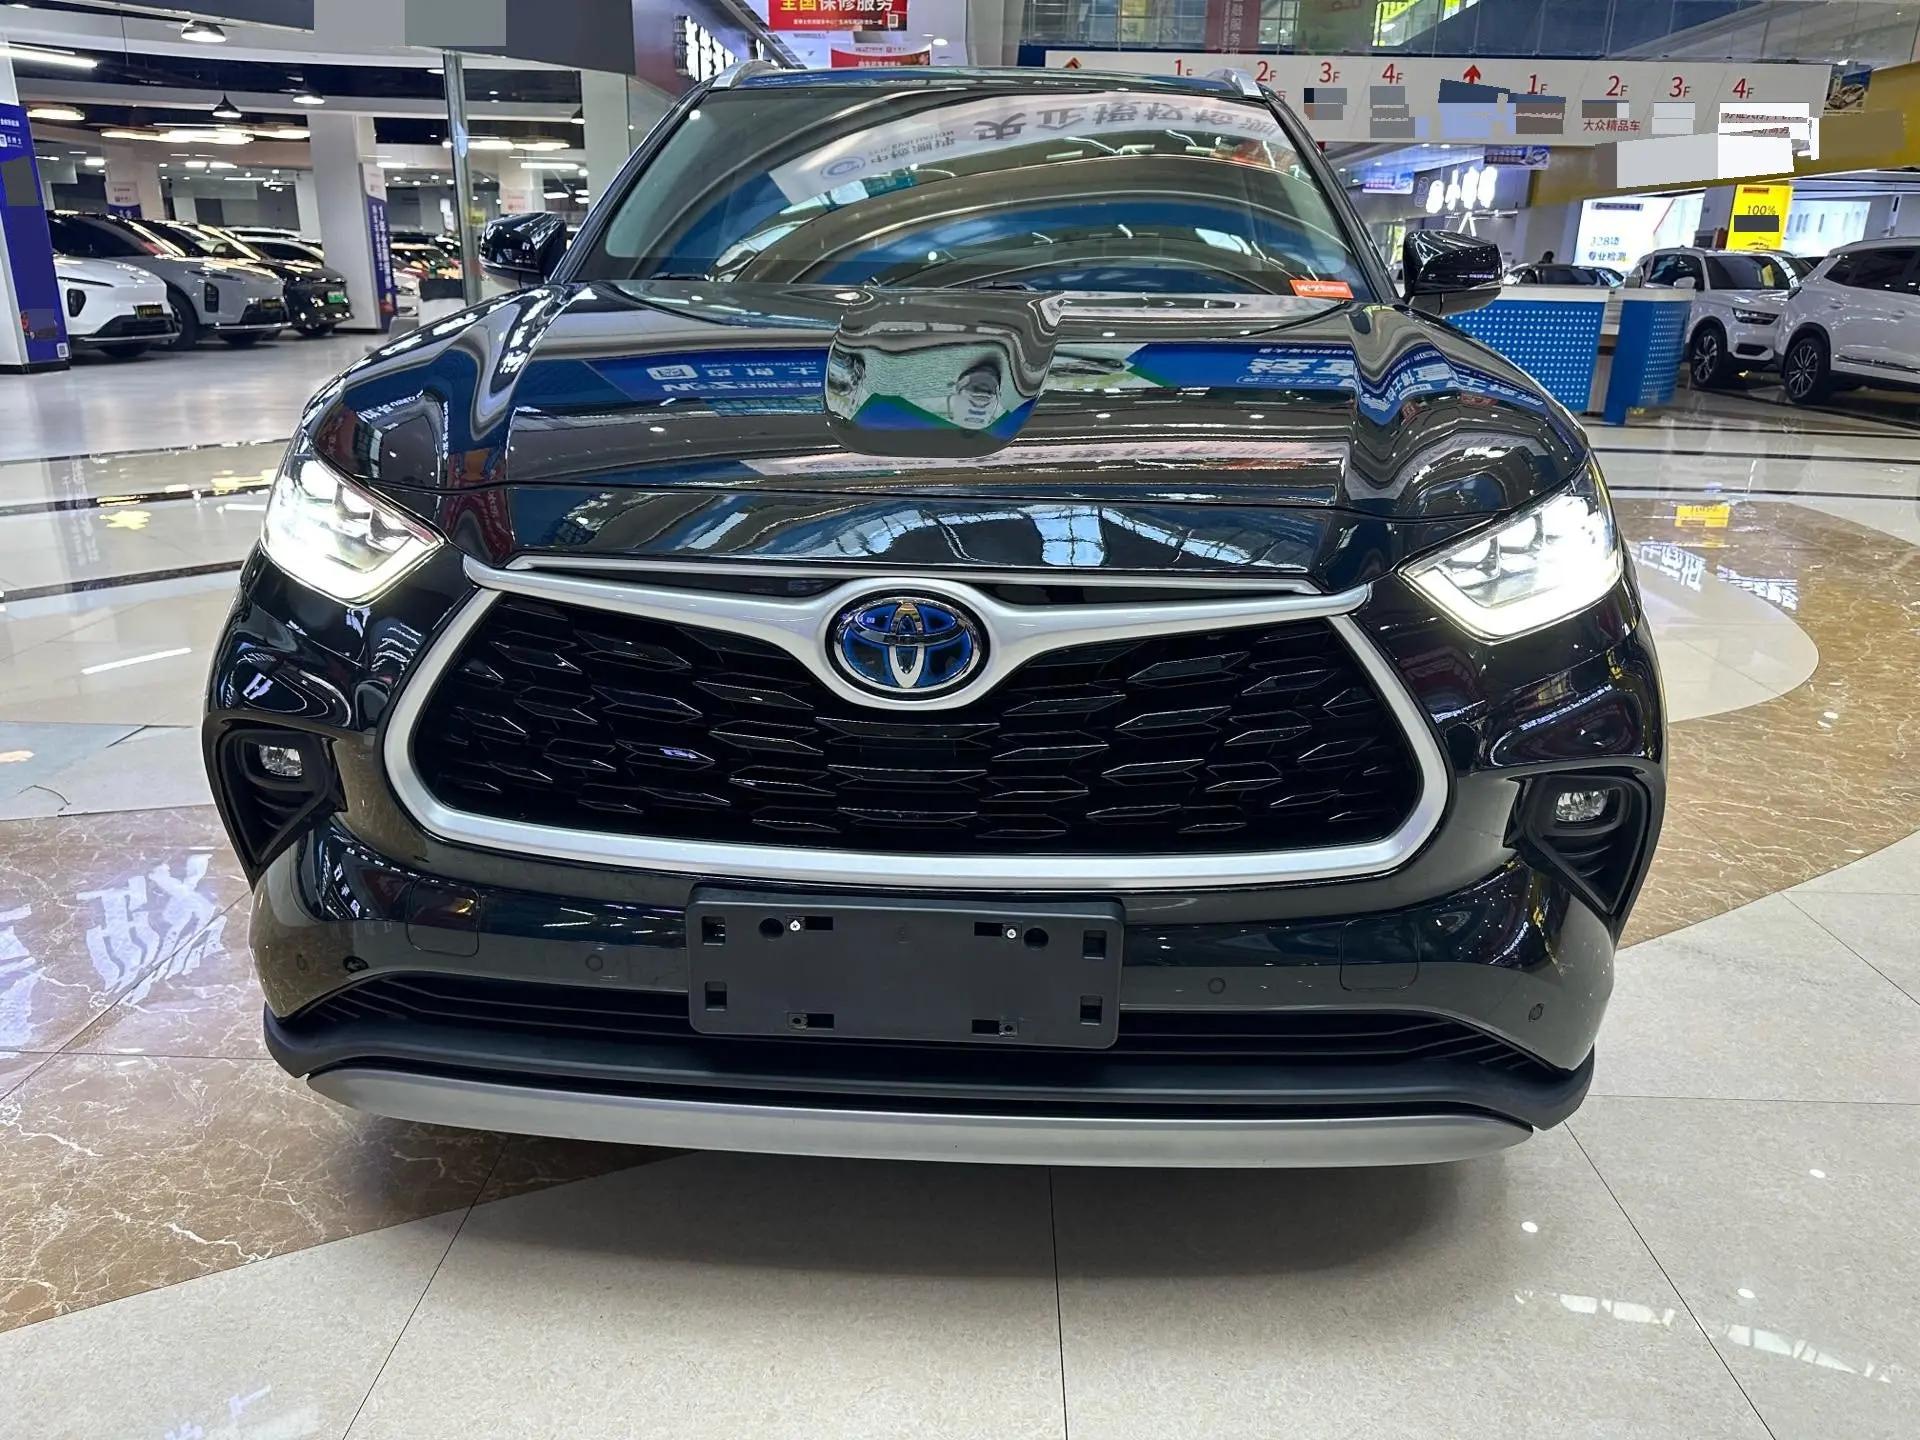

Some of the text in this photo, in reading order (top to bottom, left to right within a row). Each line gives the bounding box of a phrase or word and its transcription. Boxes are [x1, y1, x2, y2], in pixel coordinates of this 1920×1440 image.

[1256, 60, 1278, 82] 2F
[1319, 61, 1341, 84] 3F
[1382, 63, 1404, 85] 4F
[1527, 74, 1548, 96] 1F
[1606, 75, 1629, 97] 2F
[1669, 76, 1691, 98] 3F
[1732, 77, 1755, 99] 4F
[1583, 119, 1641, 132] 大众精品车
[1747, 204, 1777, 215] 100%
